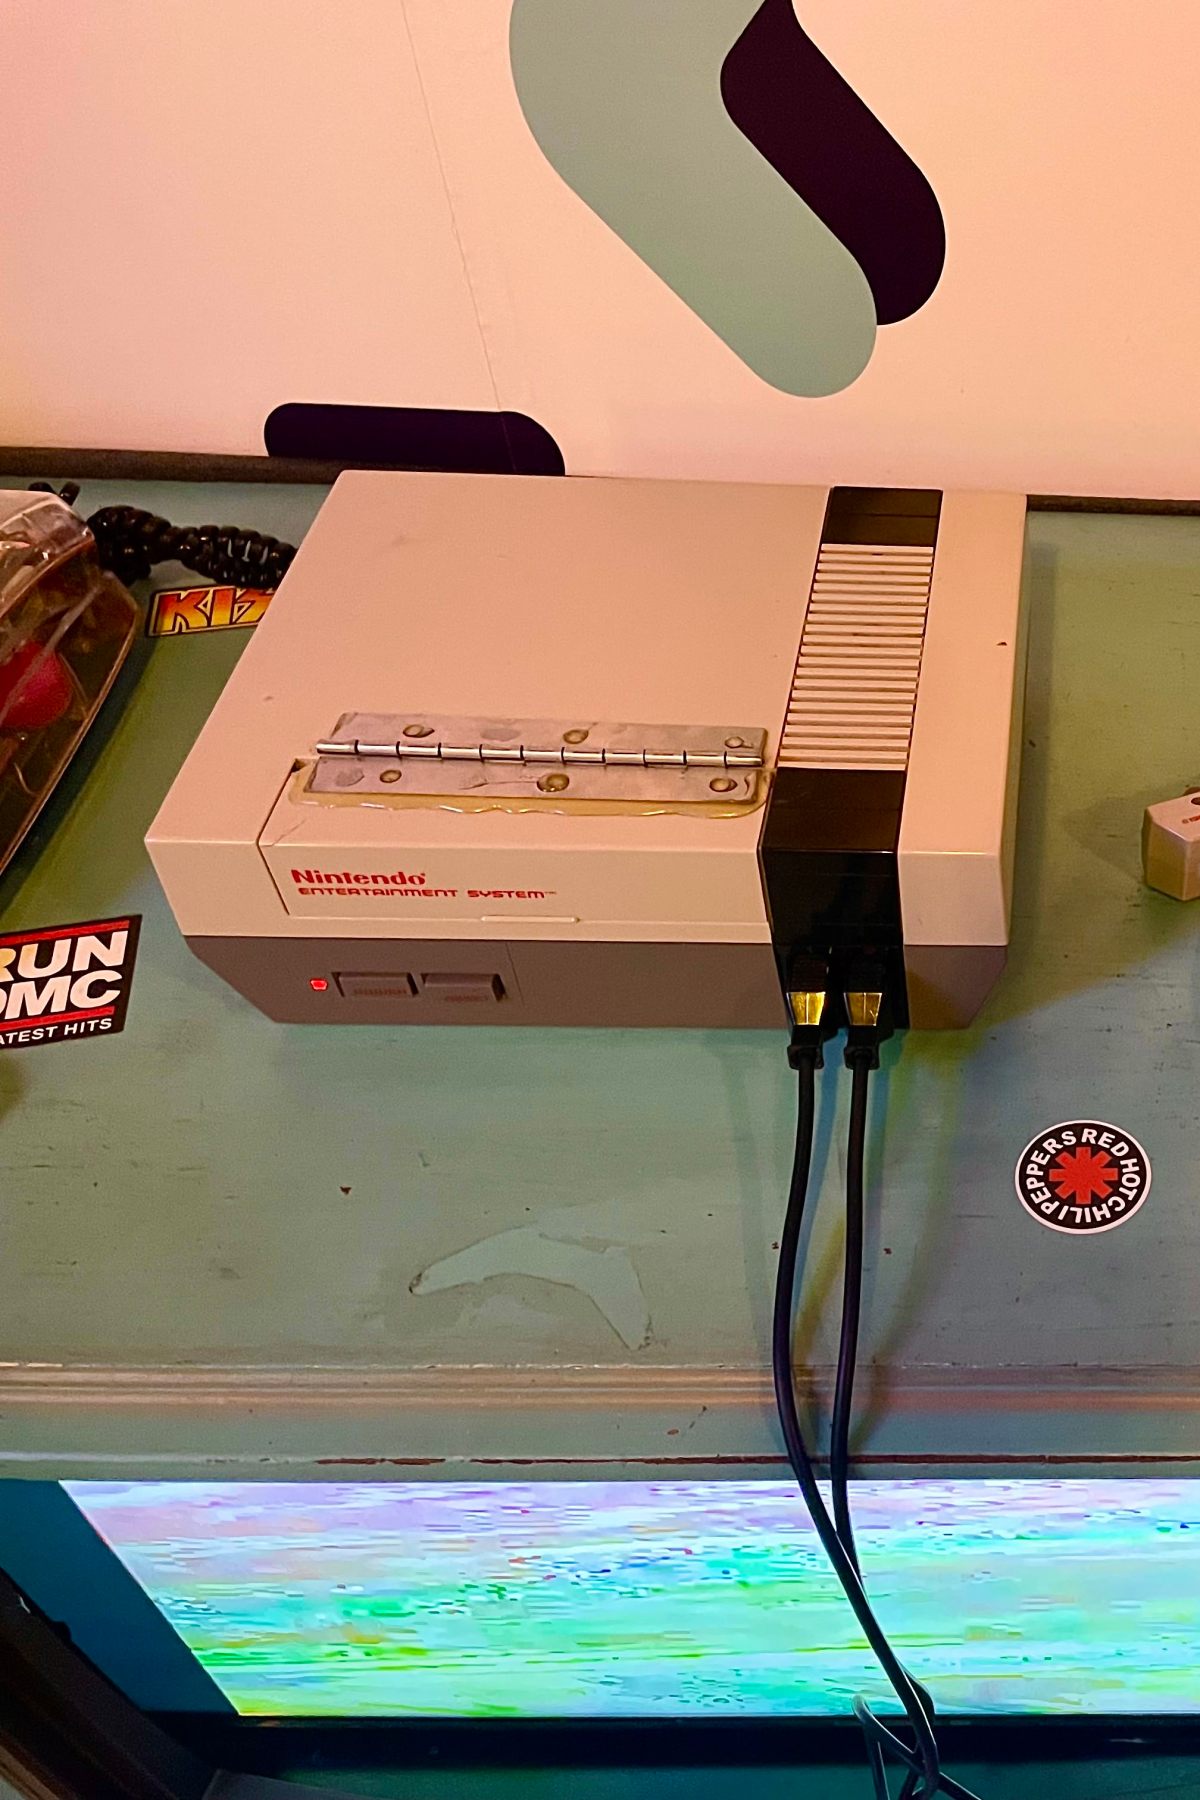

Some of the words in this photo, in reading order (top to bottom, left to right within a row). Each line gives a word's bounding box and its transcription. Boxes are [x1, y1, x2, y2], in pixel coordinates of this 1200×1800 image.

[291, 869, 425, 886] Nintendo
[298, 887, 458, 898] ENTERTAINMENT
[63, 1017, 113, 1036] HITS
[1081, 1128, 1130, 1157] RED
[1026, 1130, 1077, 1215] PEPPERS
[1118, 1157, 1141, 1201] HOT
[1057, 1195, 1126, 1223] CHILI
